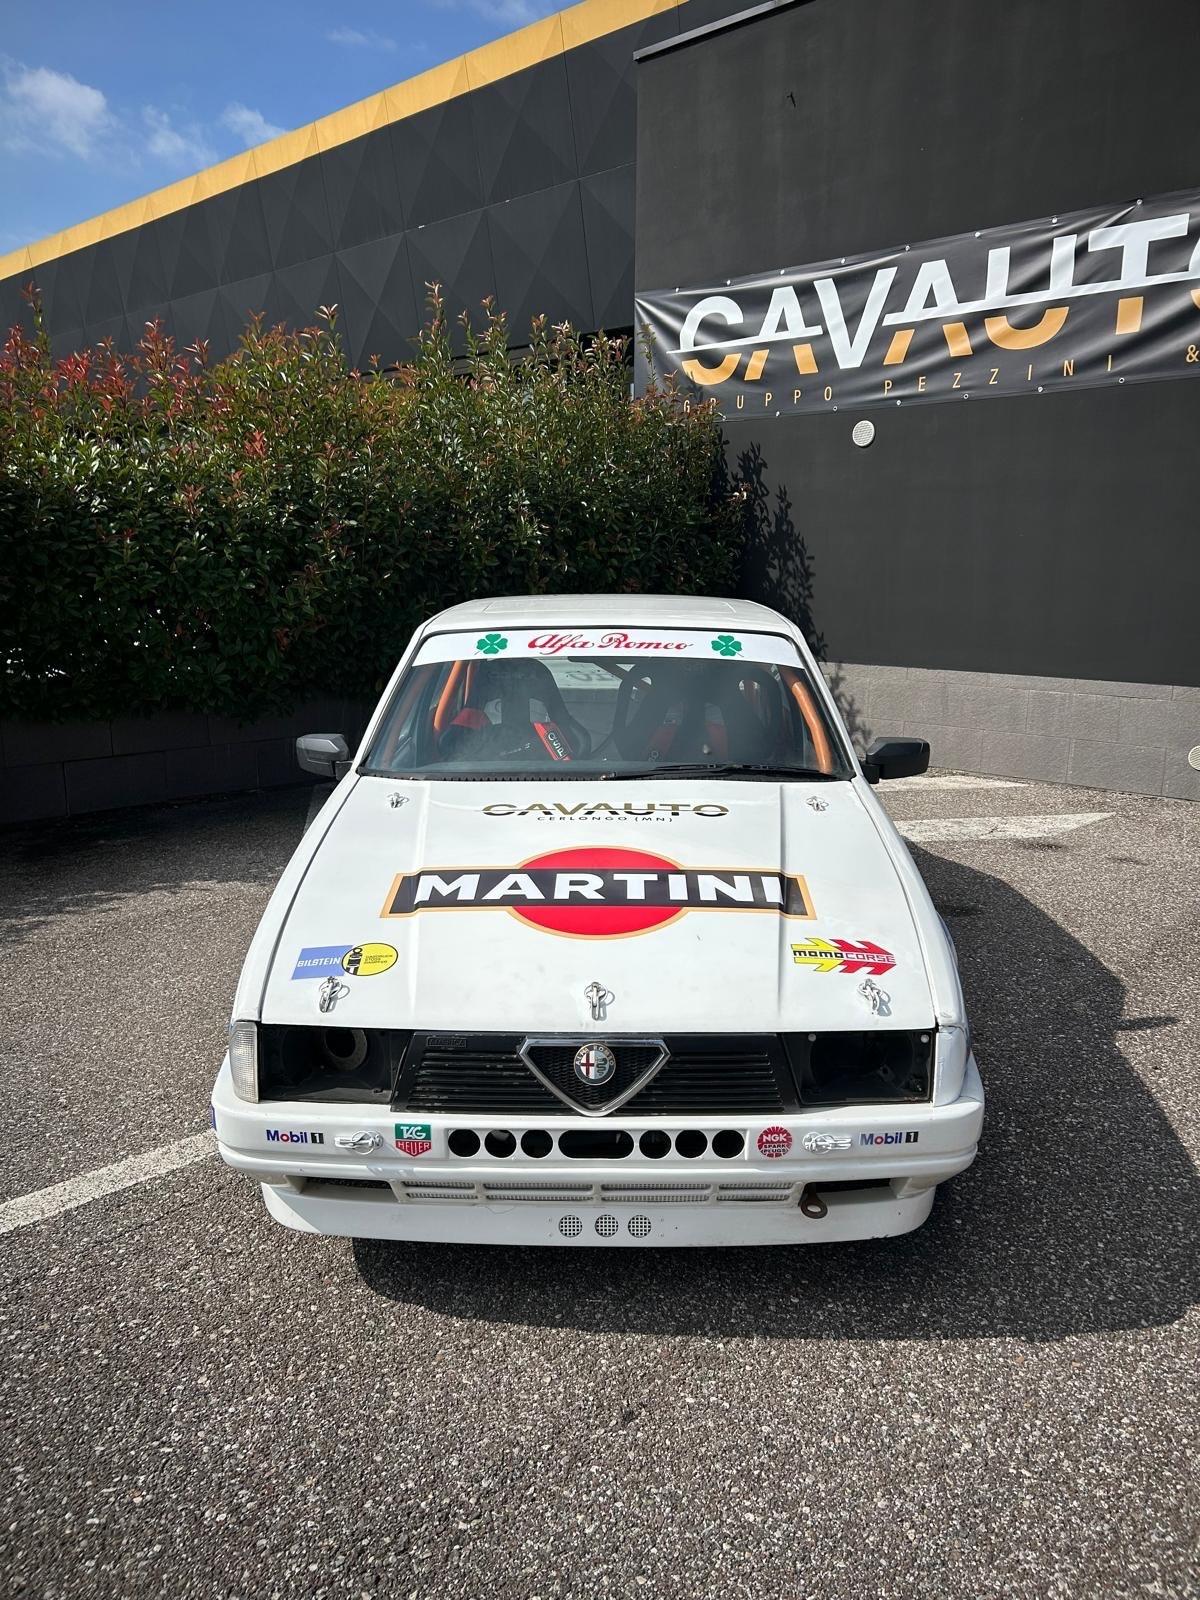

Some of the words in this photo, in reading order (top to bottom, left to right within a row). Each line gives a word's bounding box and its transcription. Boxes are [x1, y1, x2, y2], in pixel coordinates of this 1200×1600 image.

[667, 213, 1200, 386] CAVAUT
[884, 354, 1113, 397] PEZZINI
[1186, 344, 1199, 363] &
[527, 633, 596, 655] Alfa
[597, 632, 693, 651] Romeo
[481, 803, 730, 817] CAVAUTO
[413, 872, 785, 905] MARTINI
[297, 956, 341, 968] BILSTEIN
[266, 1129, 308, 1144] Mobil
[312, 1132, 323, 1144] 1
[400, 1125, 428, 1140] TAG
[762, 1133, 787, 1143] NGK
[860, 1131, 902, 1146] Mobil
[906, 1131, 917, 1143] 1
[398, 1142, 430, 1156] HEUER
